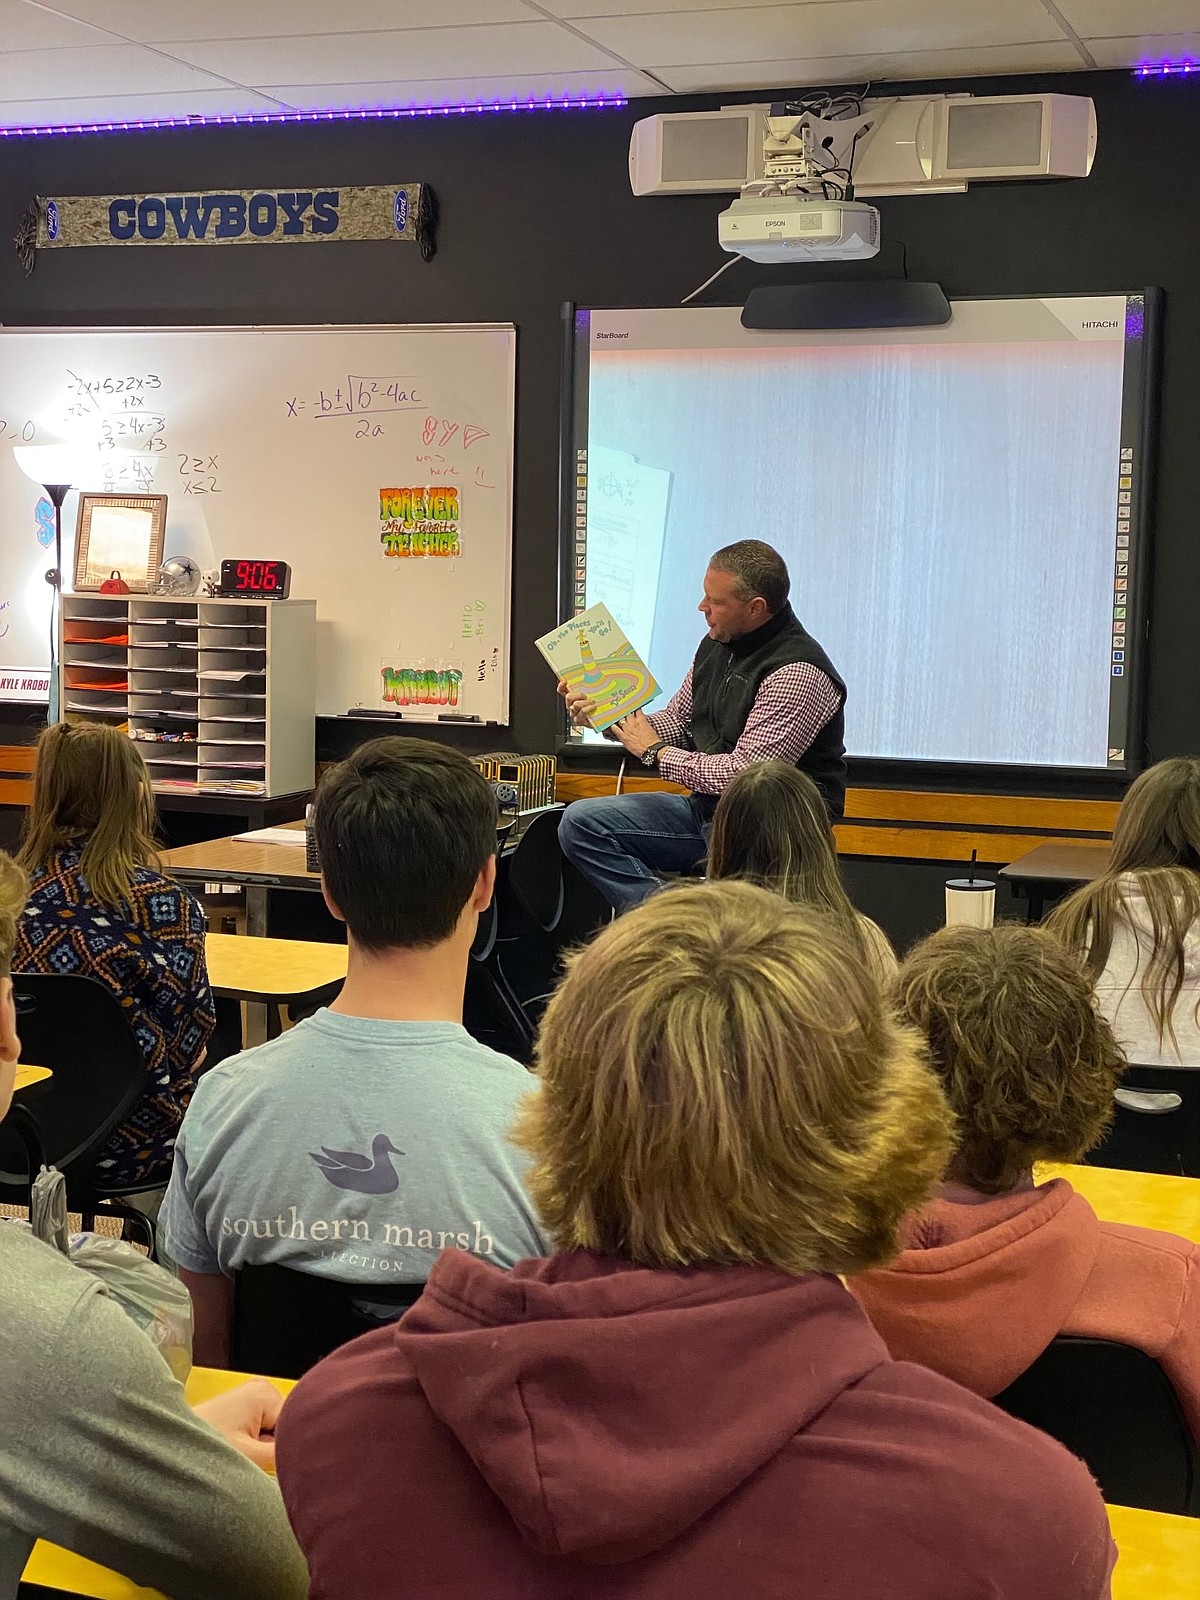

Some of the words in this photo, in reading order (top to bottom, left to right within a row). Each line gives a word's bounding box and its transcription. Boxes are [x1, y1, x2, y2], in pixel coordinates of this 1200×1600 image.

[47, 206, 58, 235] Ford
[109, 192, 339, 240] COWBOYS
[395, 196, 407, 226] Ford
[765, 220, 786, 228] EPSON
[1081, 320, 1118, 329] HITACHI
[379, 487, 459, 521] FOREVER
[381, 531, 461, 557] TEACHER
[462, 604, 473, 639] Hello
[557, 629, 569, 640] the
[567, 620, 591, 631] Places
[598, 620, 612, 636] Go!
[0, 678, 19, 690] KYLE
[221, 1206, 372, 1242] southern
[383, 1221, 495, 1255] marsh
